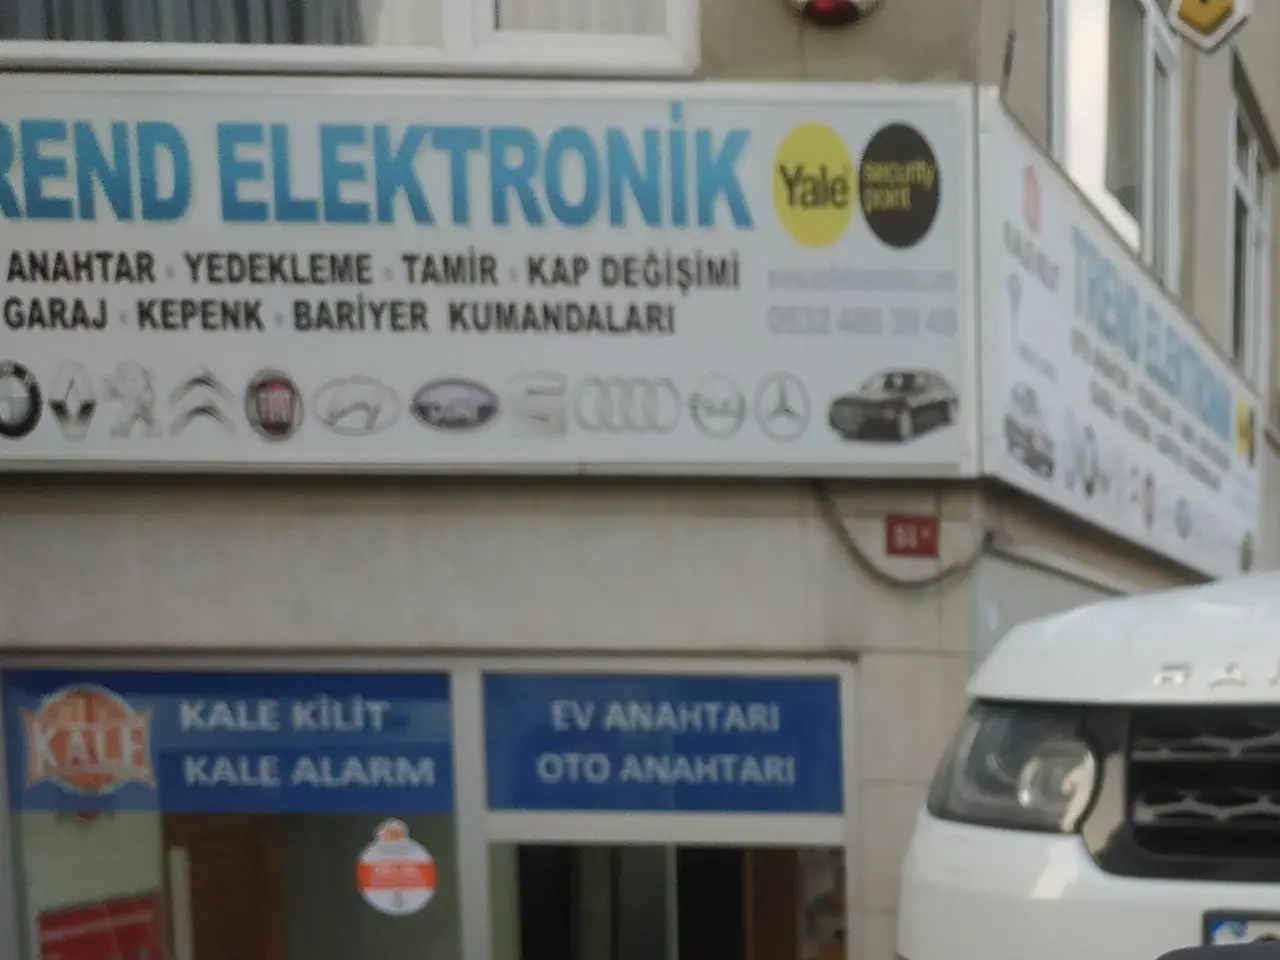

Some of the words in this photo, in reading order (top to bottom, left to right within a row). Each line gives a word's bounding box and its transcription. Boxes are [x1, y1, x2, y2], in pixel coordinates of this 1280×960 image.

[215, 101, 755, 230] ELEKTRONİK
[779, 163, 850, 209] Yale
[7, 249, 157, 284] ANAHTAR
[184, 251, 373, 285] YEDEKLEME
[402, 247, 498, 286] TAMİR
[527, 254, 589, 288] KAP
[601, 249, 741, 295] DEĞİŞİMİ
[3, 299, 108, 331] GARAJ
[137, 300, 267, 332] KEPENK
[293, 293, 430, 332] BARİYER
[449, 301, 675, 335] KUMANDALARI
[180, 699, 281, 732] KALE
[292, 694, 390, 732] KİLİT
[551, 701, 595, 731] EV
[605, 702, 780, 732] ANAHTARI
[30, 721, 146, 776] KALE
[536, 752, 611, 784] OTO
[620, 755, 795, 786] ANAHTARI
[183, 757, 281, 786] KALE
[291, 757, 436, 787] ALARM
